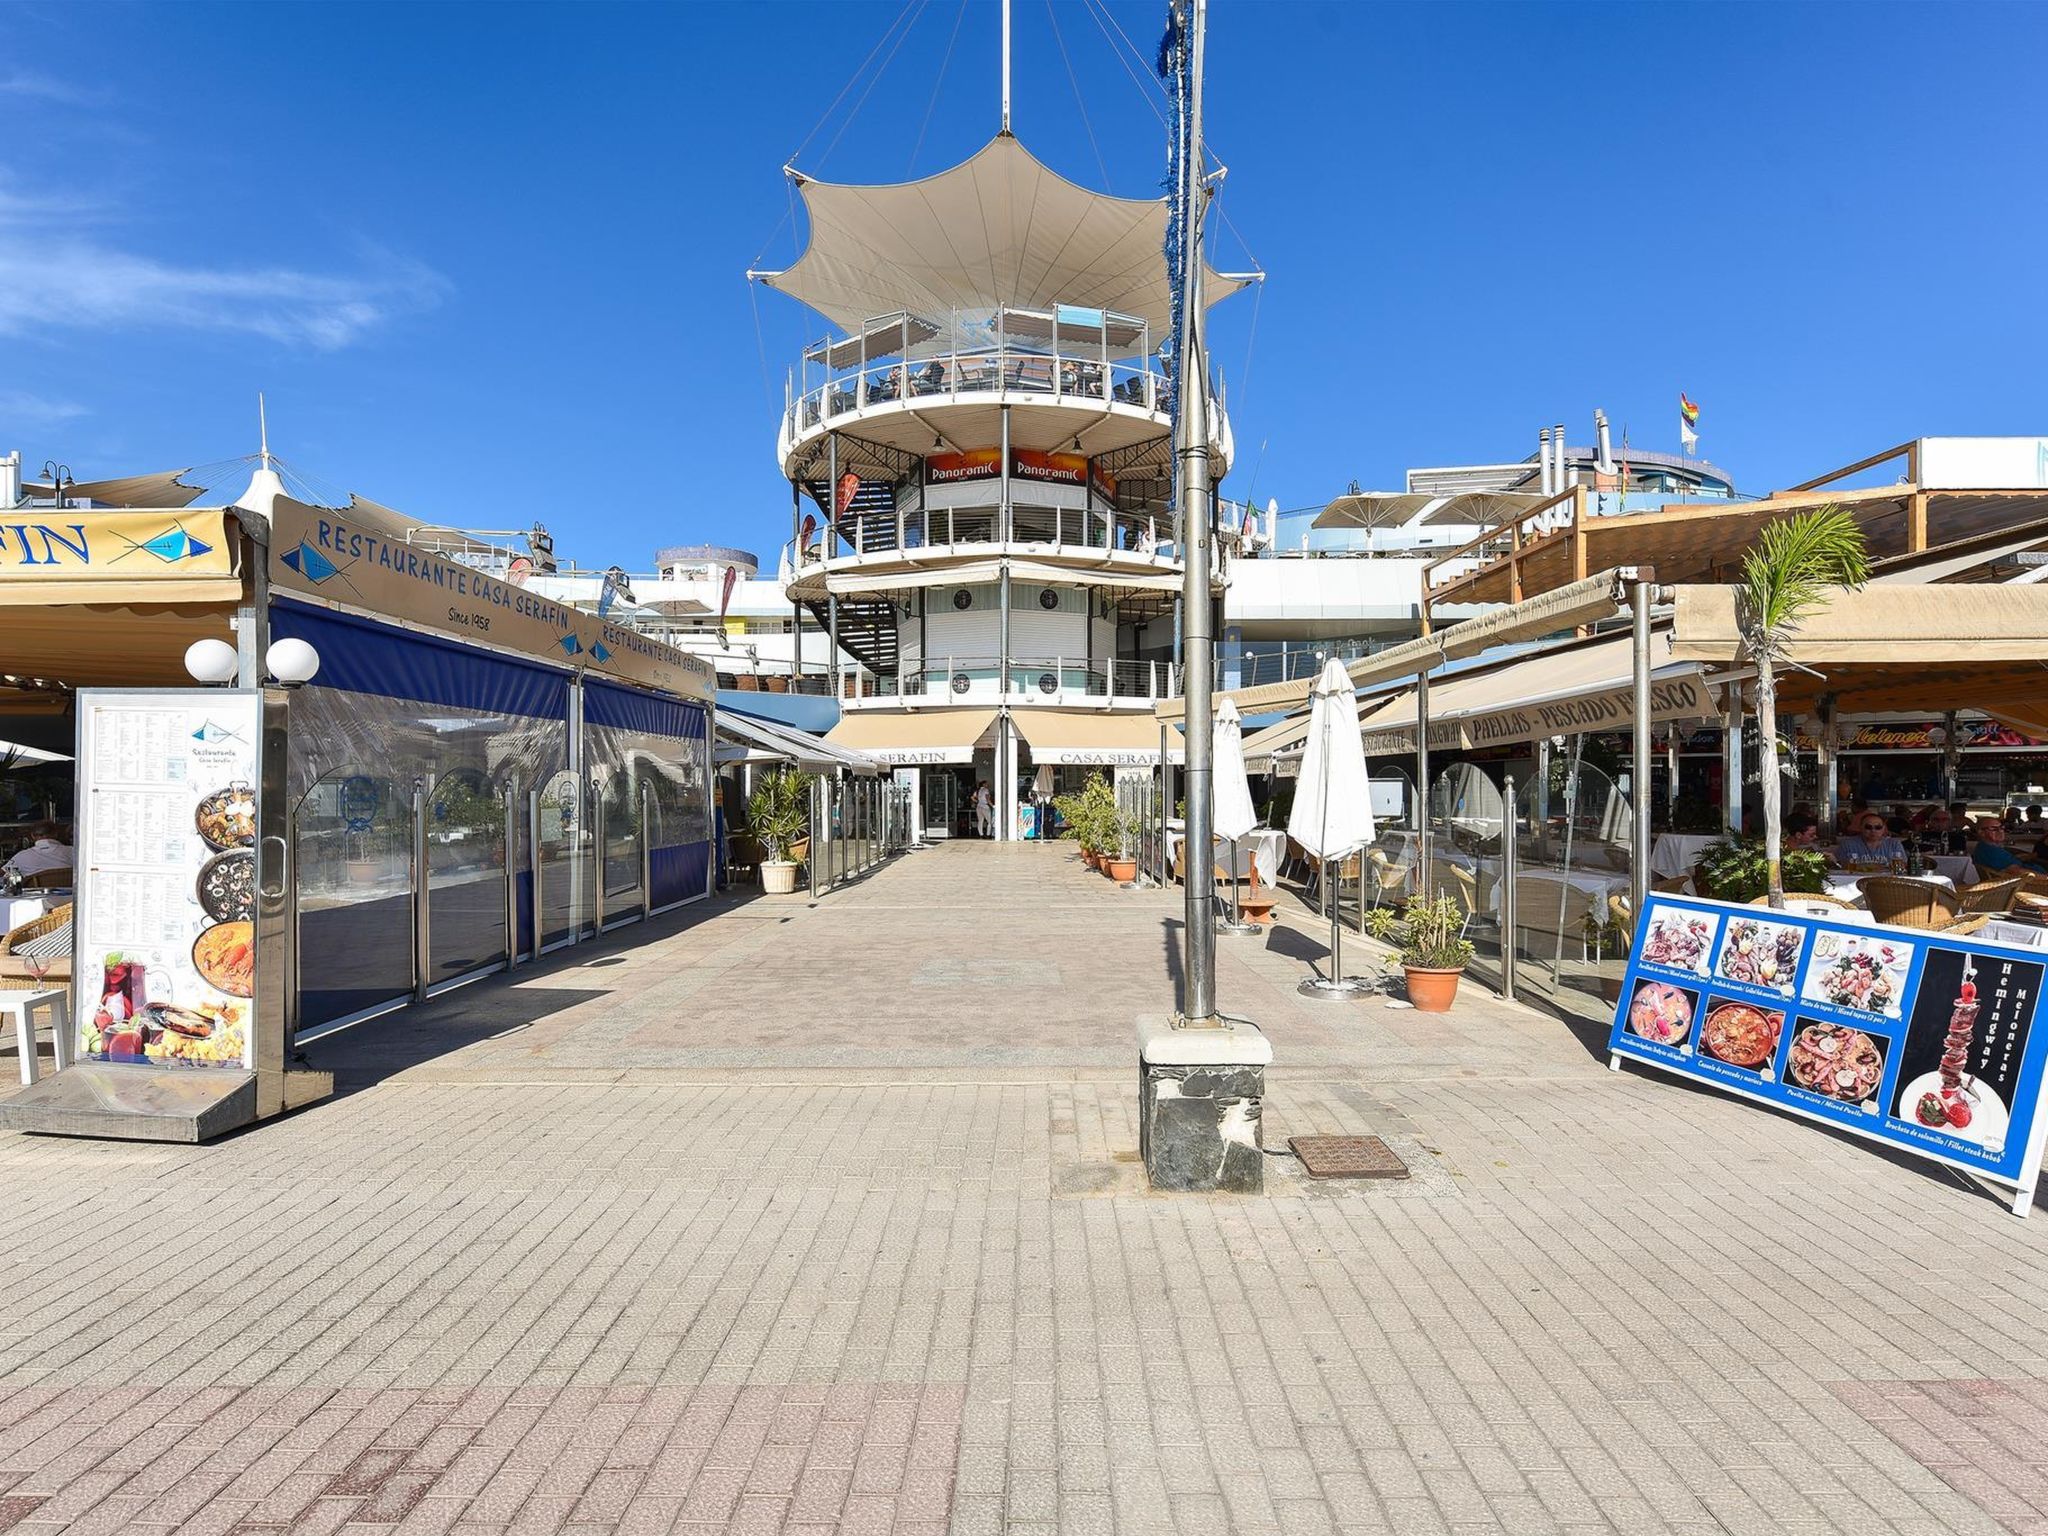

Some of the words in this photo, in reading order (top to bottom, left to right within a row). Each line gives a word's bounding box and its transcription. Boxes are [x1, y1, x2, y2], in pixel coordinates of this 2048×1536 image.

[317, 520, 467, 595] RESTAURANTE
[472, 576, 511, 607] CASA
[448, 607, 470, 626] Since
[471, 613, 490, 632] 1958
[603, 625, 662, 661] RESTAURANTE
[664, 649, 681, 666] CASA
[1472, 711, 1531, 741] PAELLAS
[1537, 697, 1619, 729] PESCADO
[1060, 753, 1103, 764] CASA
[1980, 963, 2012, 1069] Hemingway
[1998, 989, 2027, 1082] Meloneras
[1909, 1128, 1918, 1137] de
[1947, 1140, 1965, 1152] Fillet
